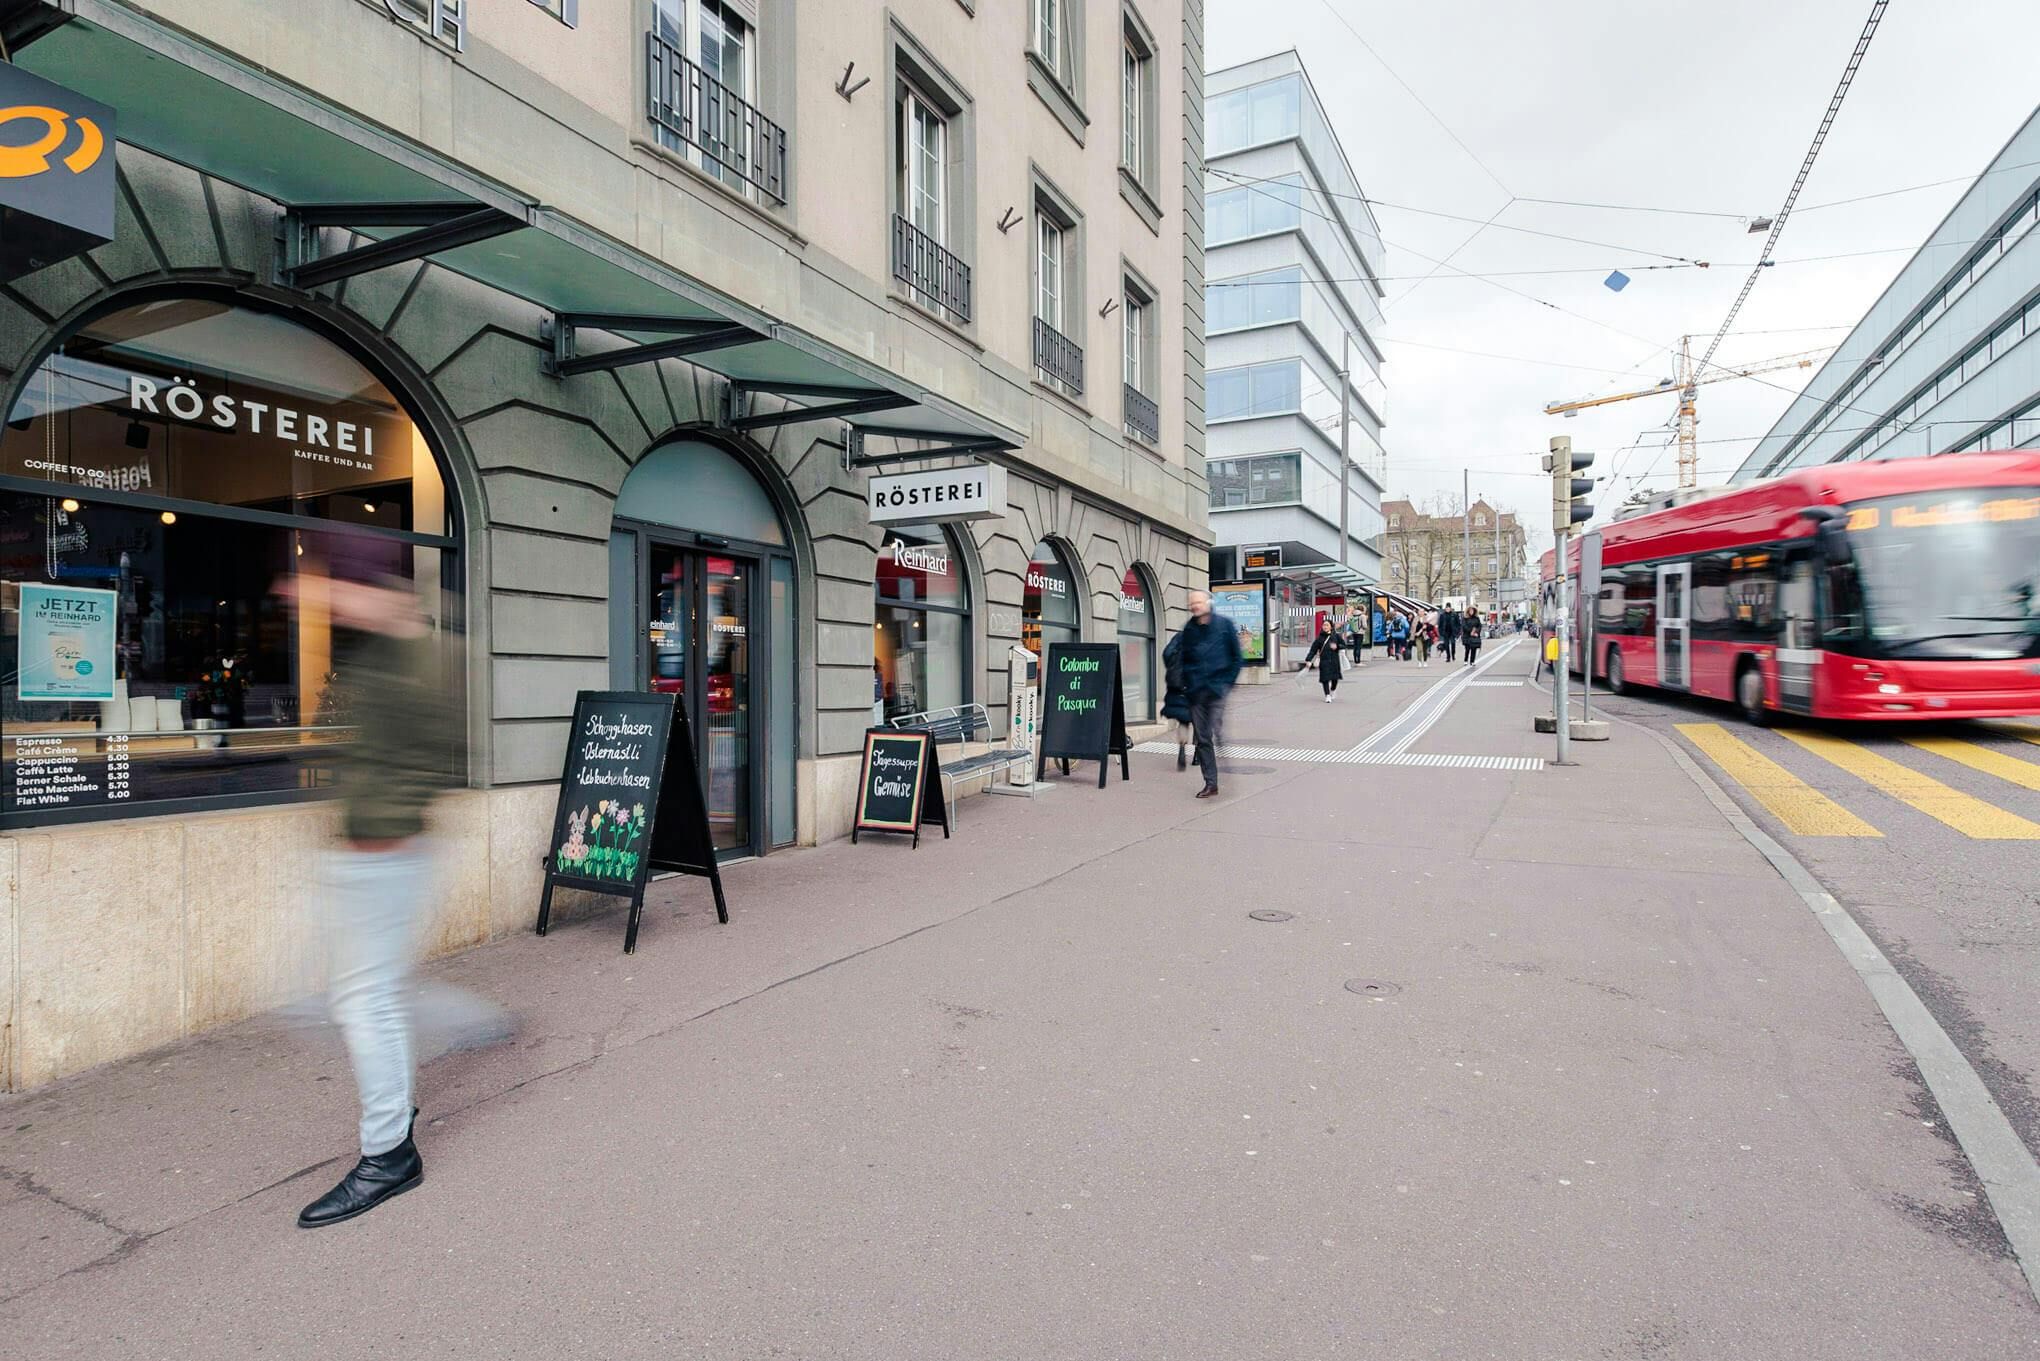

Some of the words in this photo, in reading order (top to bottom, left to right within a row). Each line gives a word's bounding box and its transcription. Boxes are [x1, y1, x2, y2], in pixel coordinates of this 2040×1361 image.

[131, 375, 373, 456] RÖSTEREI
[24, 459, 68, 473] COFFEE
[69, 466, 86, 476] TO
[87, 469, 105, 479] GO
[294, 449, 330, 463] KAFFEE
[333, 457, 353, 467] UND
[356, 461, 373, 471] BAR
[876, 482, 982, 508] RÖSTEREI
[894, 538, 947, 575] Reinhard
[1028, 572, 1065, 593] RÖSTEREI
[40, 598, 98, 613] JETZT
[1119, 590, 1145, 613] Reinhard
[50, 611, 101, 622] REINHARD
[650, 620, 675, 630] einhard
[1060, 657, 1100, 672] Colomba
[1070, 676, 1081, 690] di
[1058, 695, 1097, 715] Pasqua
[585, 714, 653, 740] Schoggihasen
[16, 738, 62, 747] Espresso
[107, 735, 129, 743] 4.30
[16, 747, 41, 756] Café
[43, 746, 77, 755] Crème
[107, 744, 129, 752] 4.30
[16, 757, 78, 767] Cappuccino
[107, 753, 129, 761] 5.00
[16, 767, 45, 776] Caffè
[47, 765, 73, 774] Latte
[107, 762, 130, 771] 5.30
[873, 749, 918, 771] Tagessuppe
[16, 777, 51, 786] Berner
[52, 774, 87, 784] Schale
[107, 772, 130, 780] 5.30
[580, 766, 650, 789] Lebkuchenhasen
[16, 787, 44, 796] Latte
[46, 783, 98, 793] Macchiato
[108, 781, 129, 789] 5.70
[874, 776, 912, 798] Gemüse
[17, 796, 36, 806] Flat
[38, 794, 69, 804] White
[108, 790, 130, 799] 6.00
